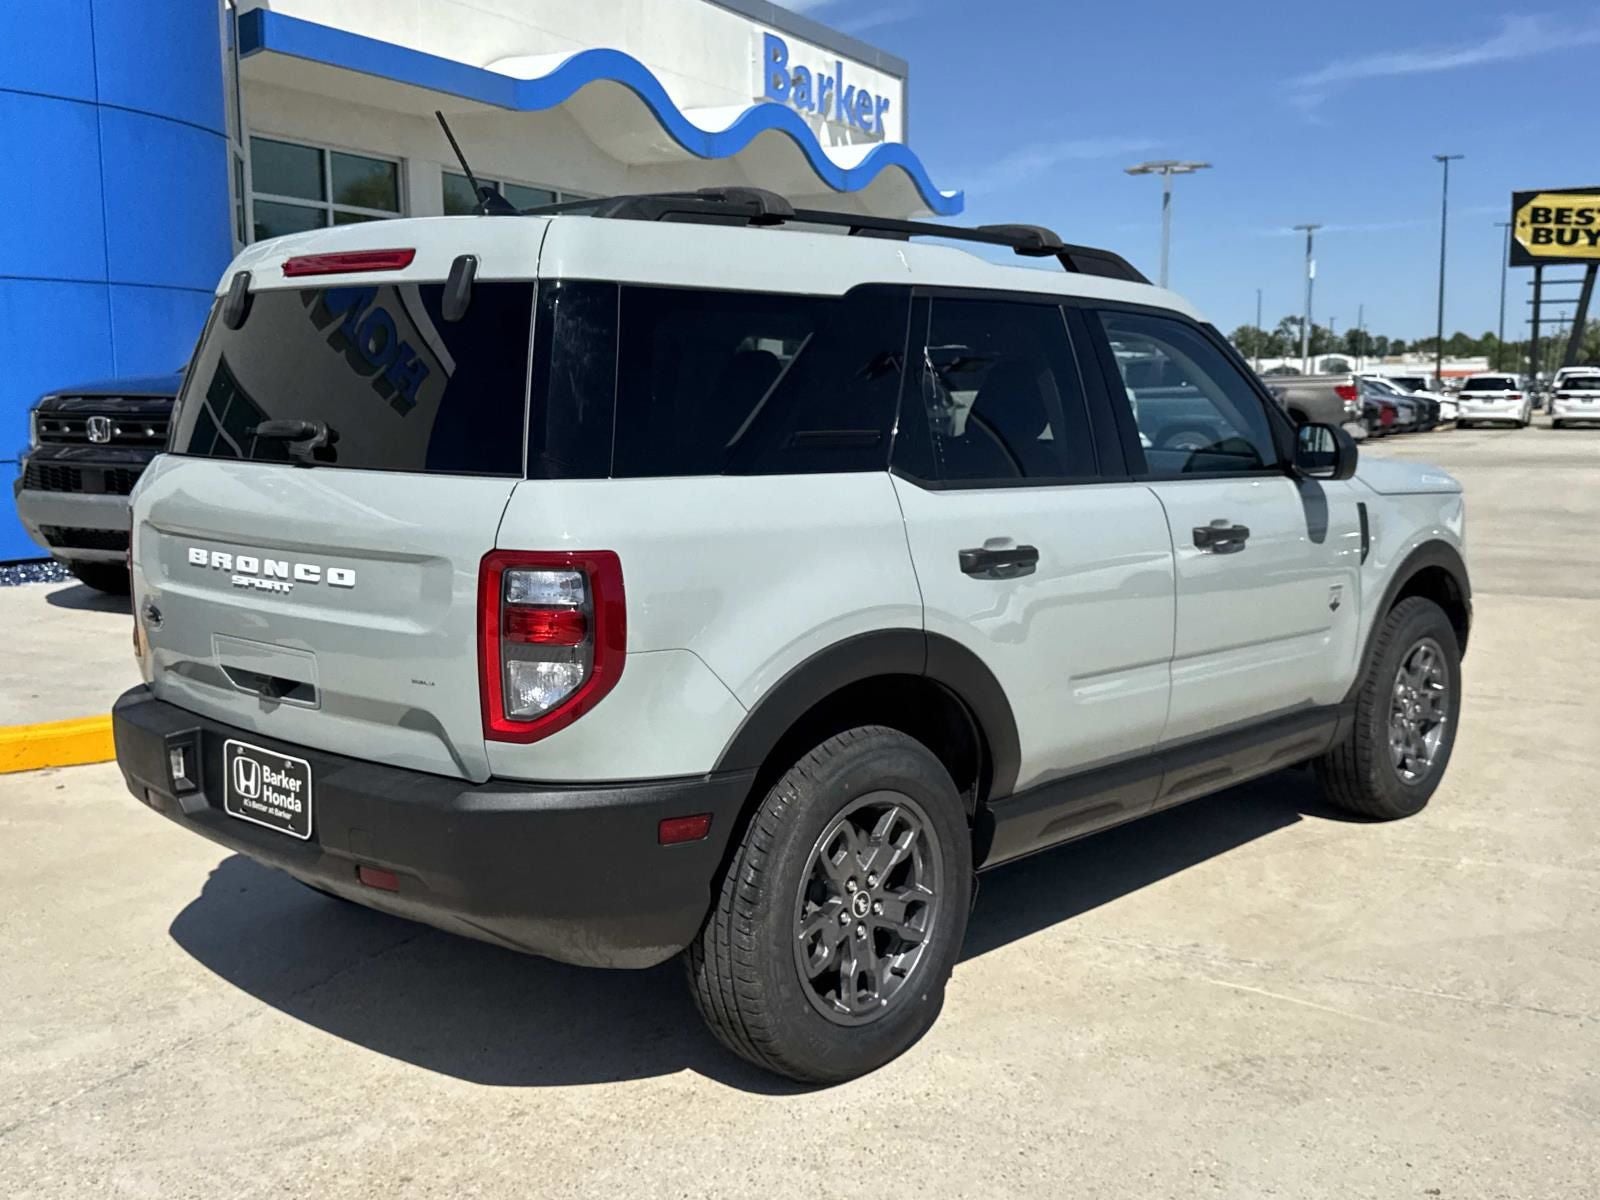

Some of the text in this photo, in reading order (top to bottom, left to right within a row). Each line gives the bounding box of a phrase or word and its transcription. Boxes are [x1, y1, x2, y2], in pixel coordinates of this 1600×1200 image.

[763, 32, 890, 134] Barker
[1530, 207, 1600, 225] BES
[1531, 228, 1600, 246] BUY
[188, 547, 356, 587] BRONCO
[231, 575, 294, 593] SPORT
[262, 765, 302, 793] Barker
[263, 784, 302, 813] Honda
